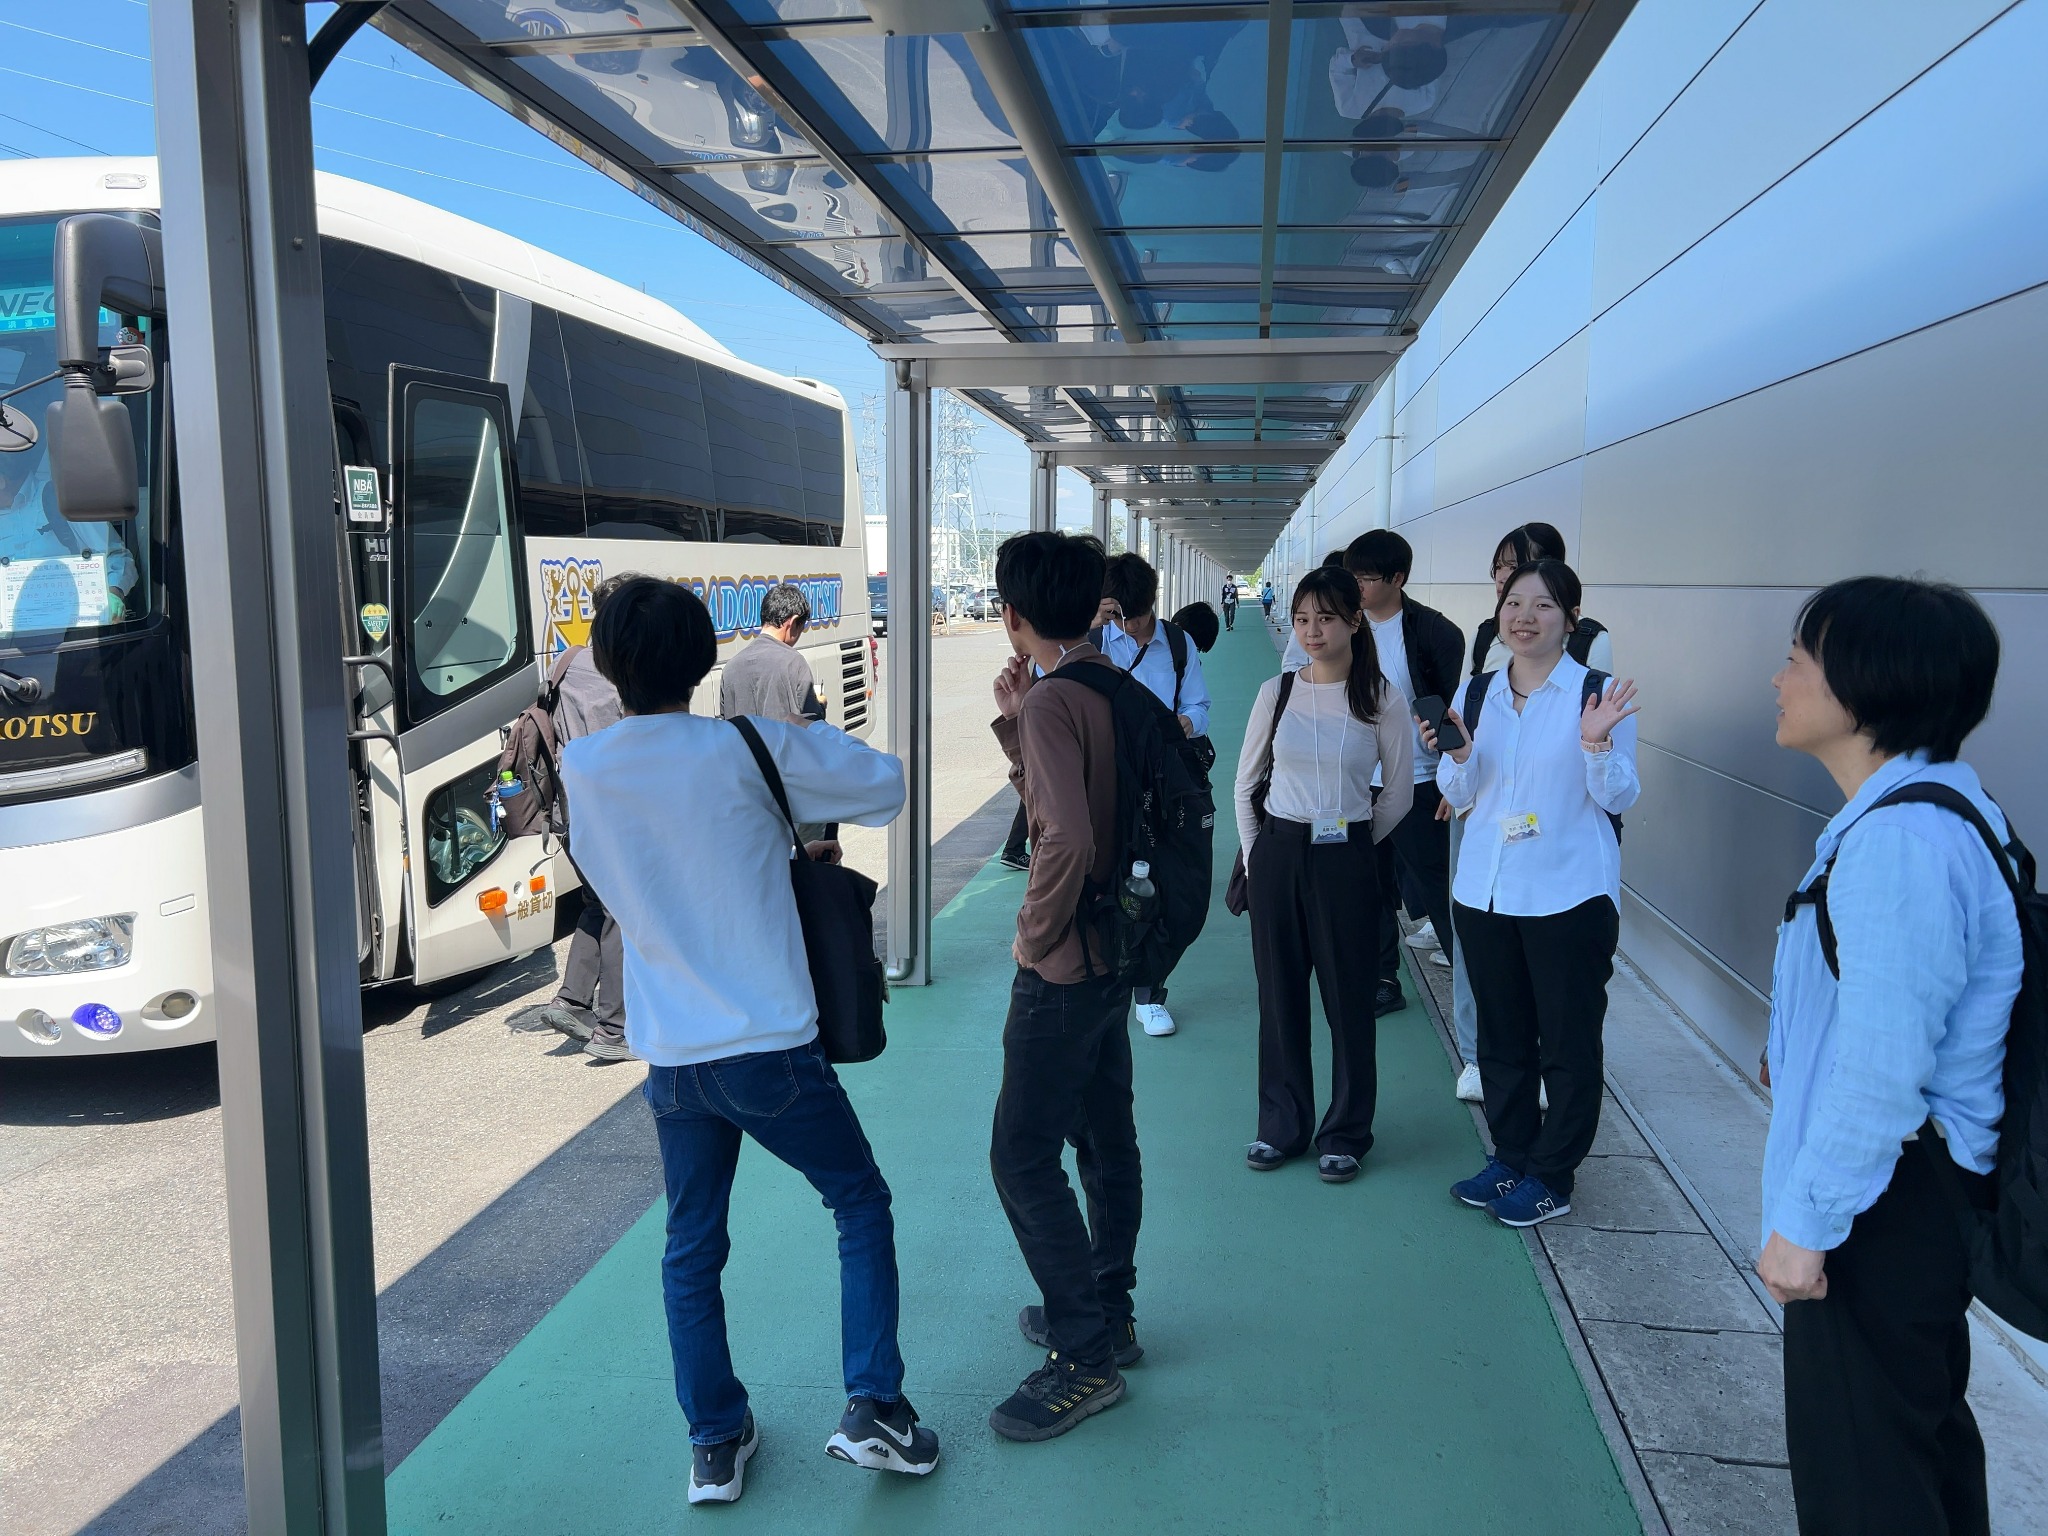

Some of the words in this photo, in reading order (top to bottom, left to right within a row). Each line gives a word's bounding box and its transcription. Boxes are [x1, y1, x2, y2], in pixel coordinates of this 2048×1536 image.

[353, 478, 373, 491] NBA
[365, 538, 389, 553] HI
[76, 562, 100, 570] TEPCO
[505, 891, 553, 920] 一般貸切
